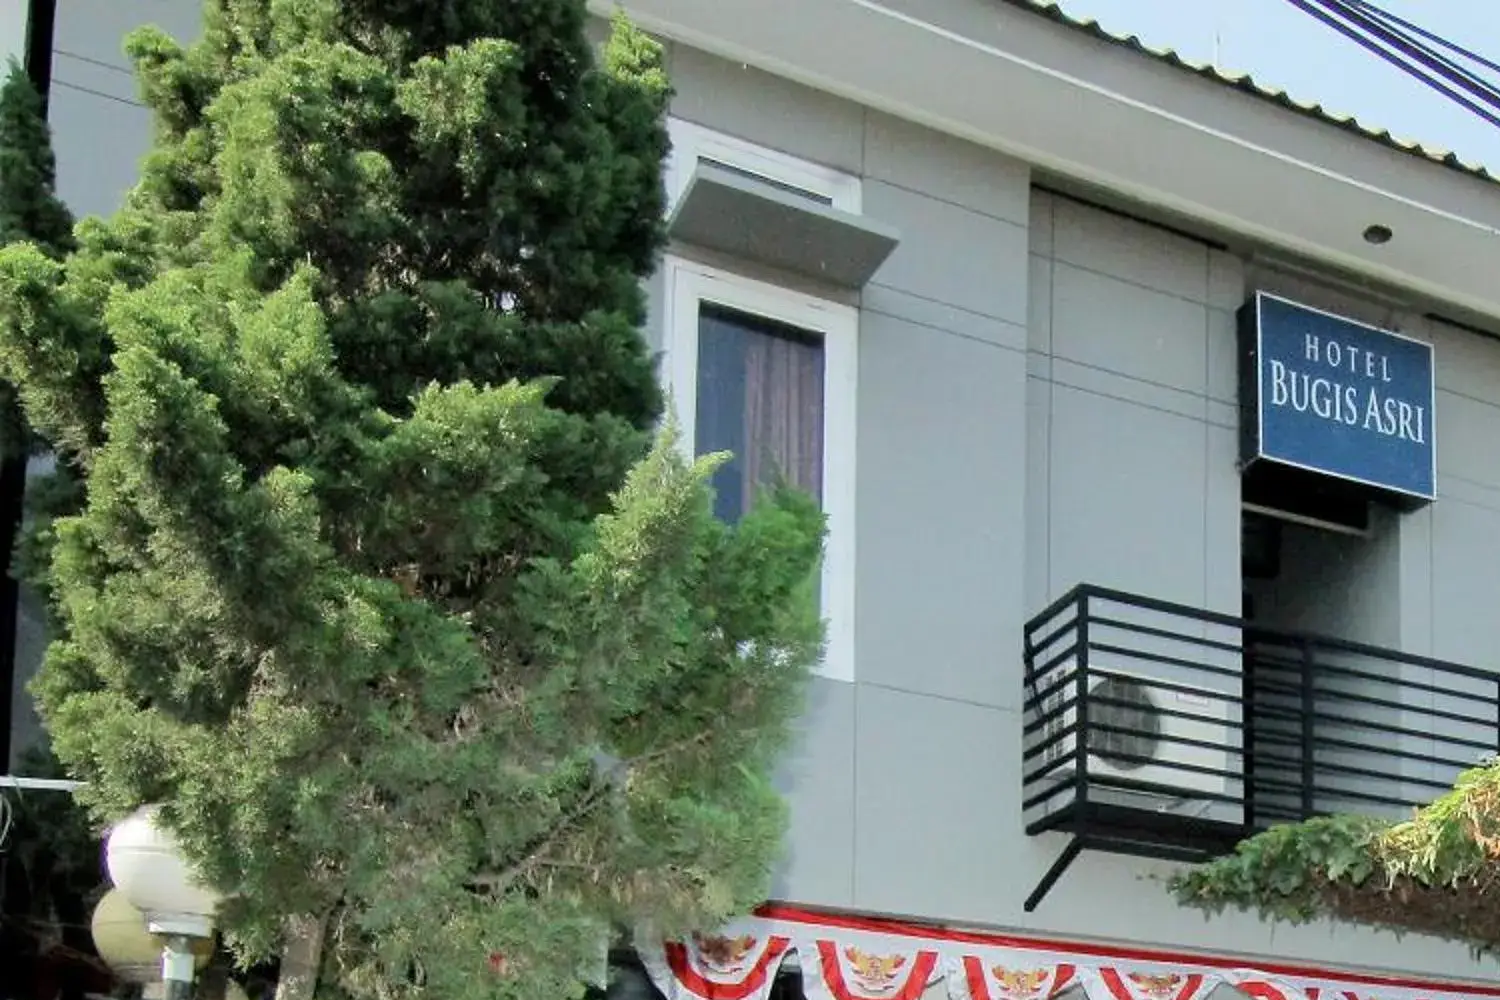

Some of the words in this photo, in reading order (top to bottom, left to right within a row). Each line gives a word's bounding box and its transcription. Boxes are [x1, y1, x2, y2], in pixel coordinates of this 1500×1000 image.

[1304, 333, 1392, 382] HOTEL
[1270, 359, 1357, 426] BUGIS
[1362, 386, 1425, 444] ASRI
